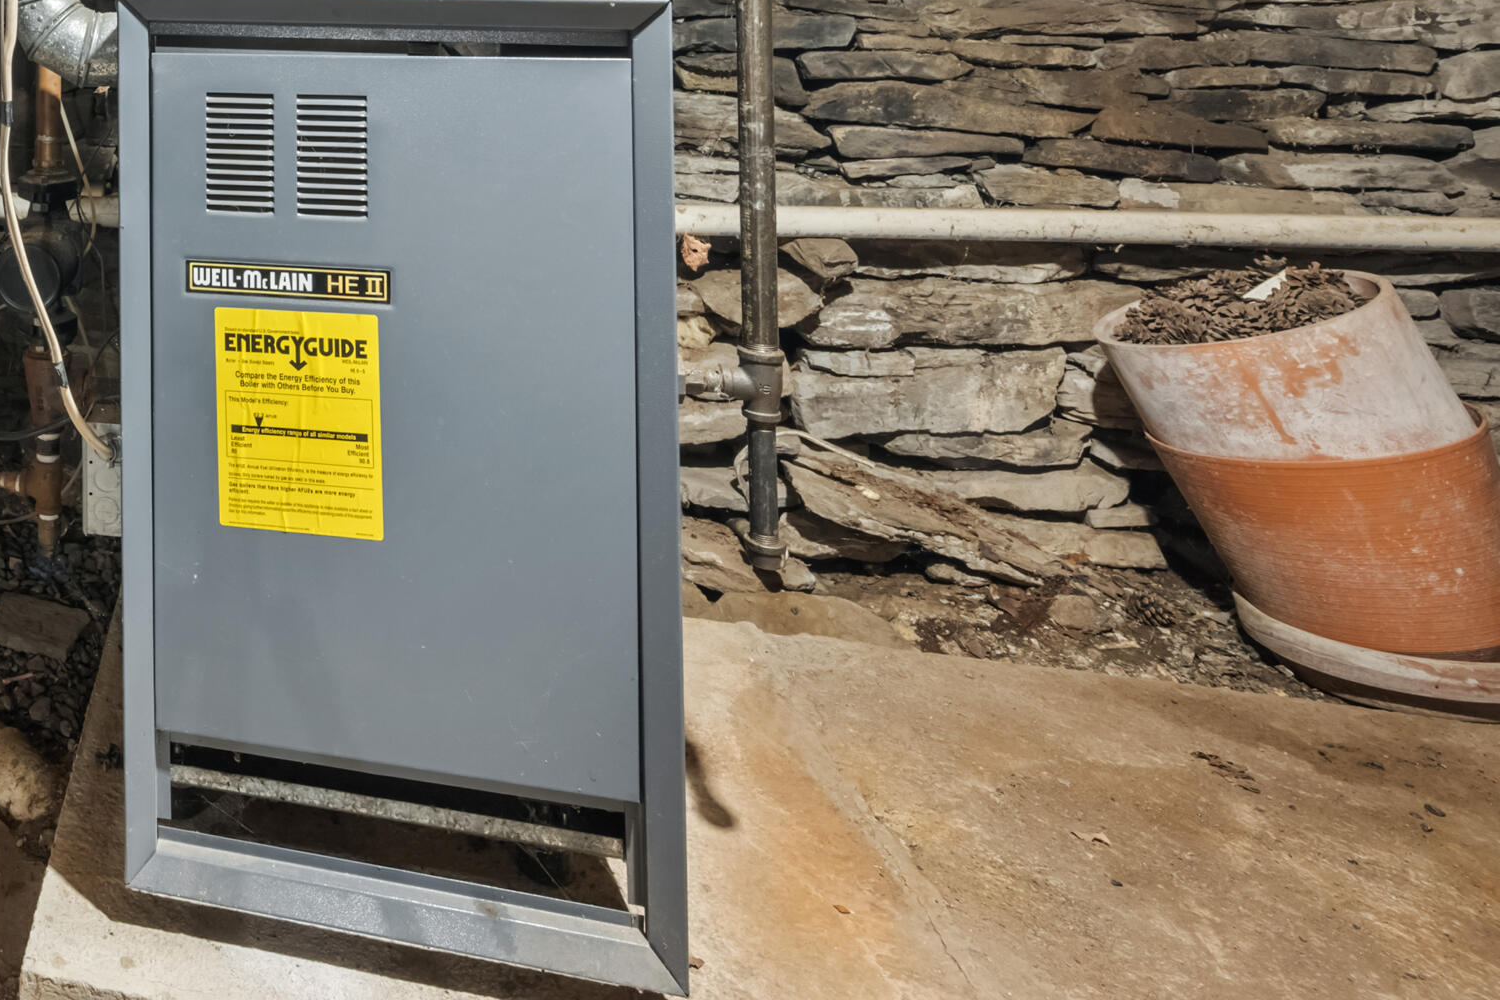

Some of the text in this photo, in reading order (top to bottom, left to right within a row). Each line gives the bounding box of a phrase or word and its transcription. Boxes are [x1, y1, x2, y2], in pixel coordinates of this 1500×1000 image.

[193, 266, 383, 296] WEIL-McLAIN HE II
[224, 333, 368, 359] ENERGYGUIDE
[235, 371, 360, 386] Compare the Energy Efficiency of this
[240, 380, 260, 388] Boiler
[278, 382, 300, 391] Others
[302, 384, 324, 392] Before
[326, 385, 339, 393] You
[341, 386, 355, 395] Buy.
[242, 426, 260, 434] Energy
[261, 428, 286, 436] efficiency
[287, 430, 302, 438] range
